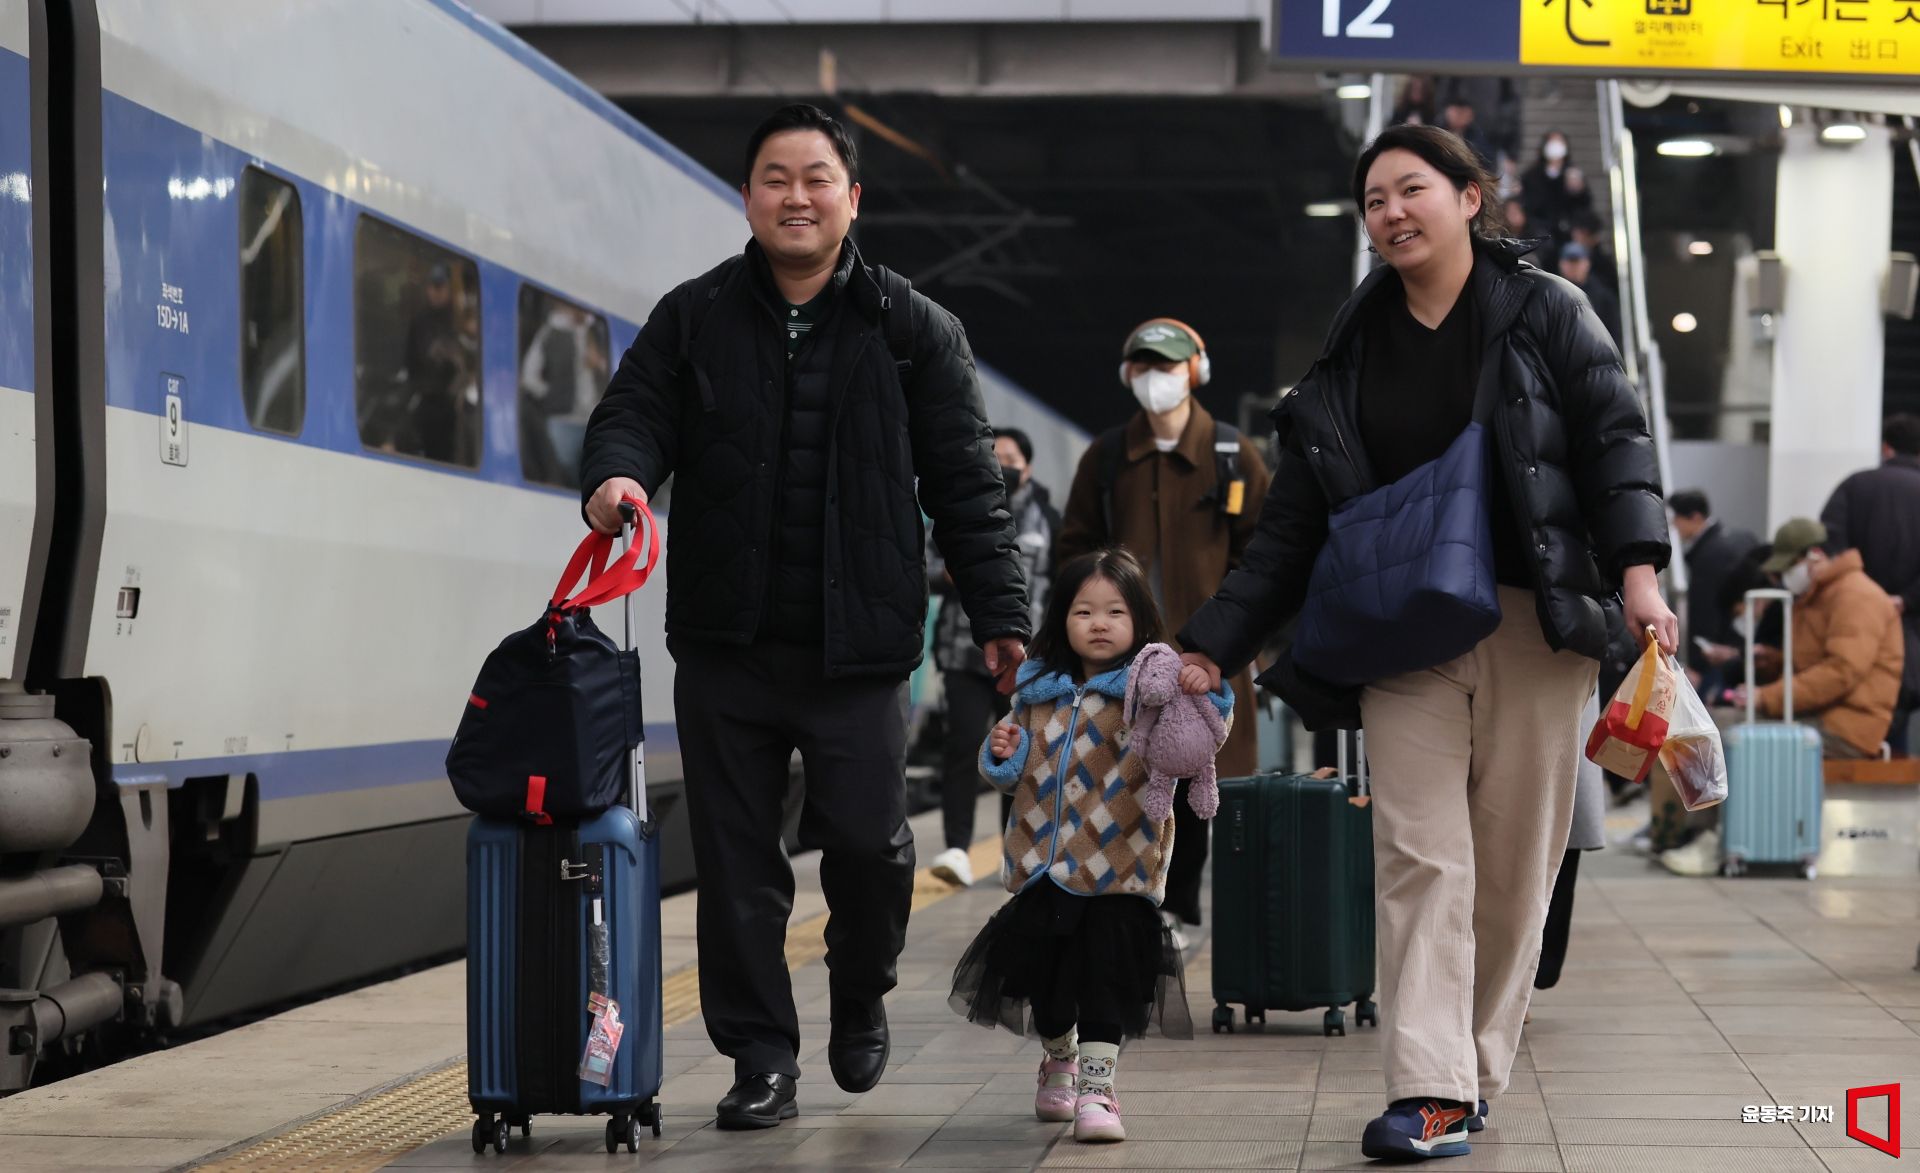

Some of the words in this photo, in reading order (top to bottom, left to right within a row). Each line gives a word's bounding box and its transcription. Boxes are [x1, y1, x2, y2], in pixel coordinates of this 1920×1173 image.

[1322, 0, 1394, 38] 12
[1781, 36, 1821, 58] Exit
[1850, 39, 1897, 59] 出口
[167, 378, 179, 394] car
[170, 402, 177, 437] 9
